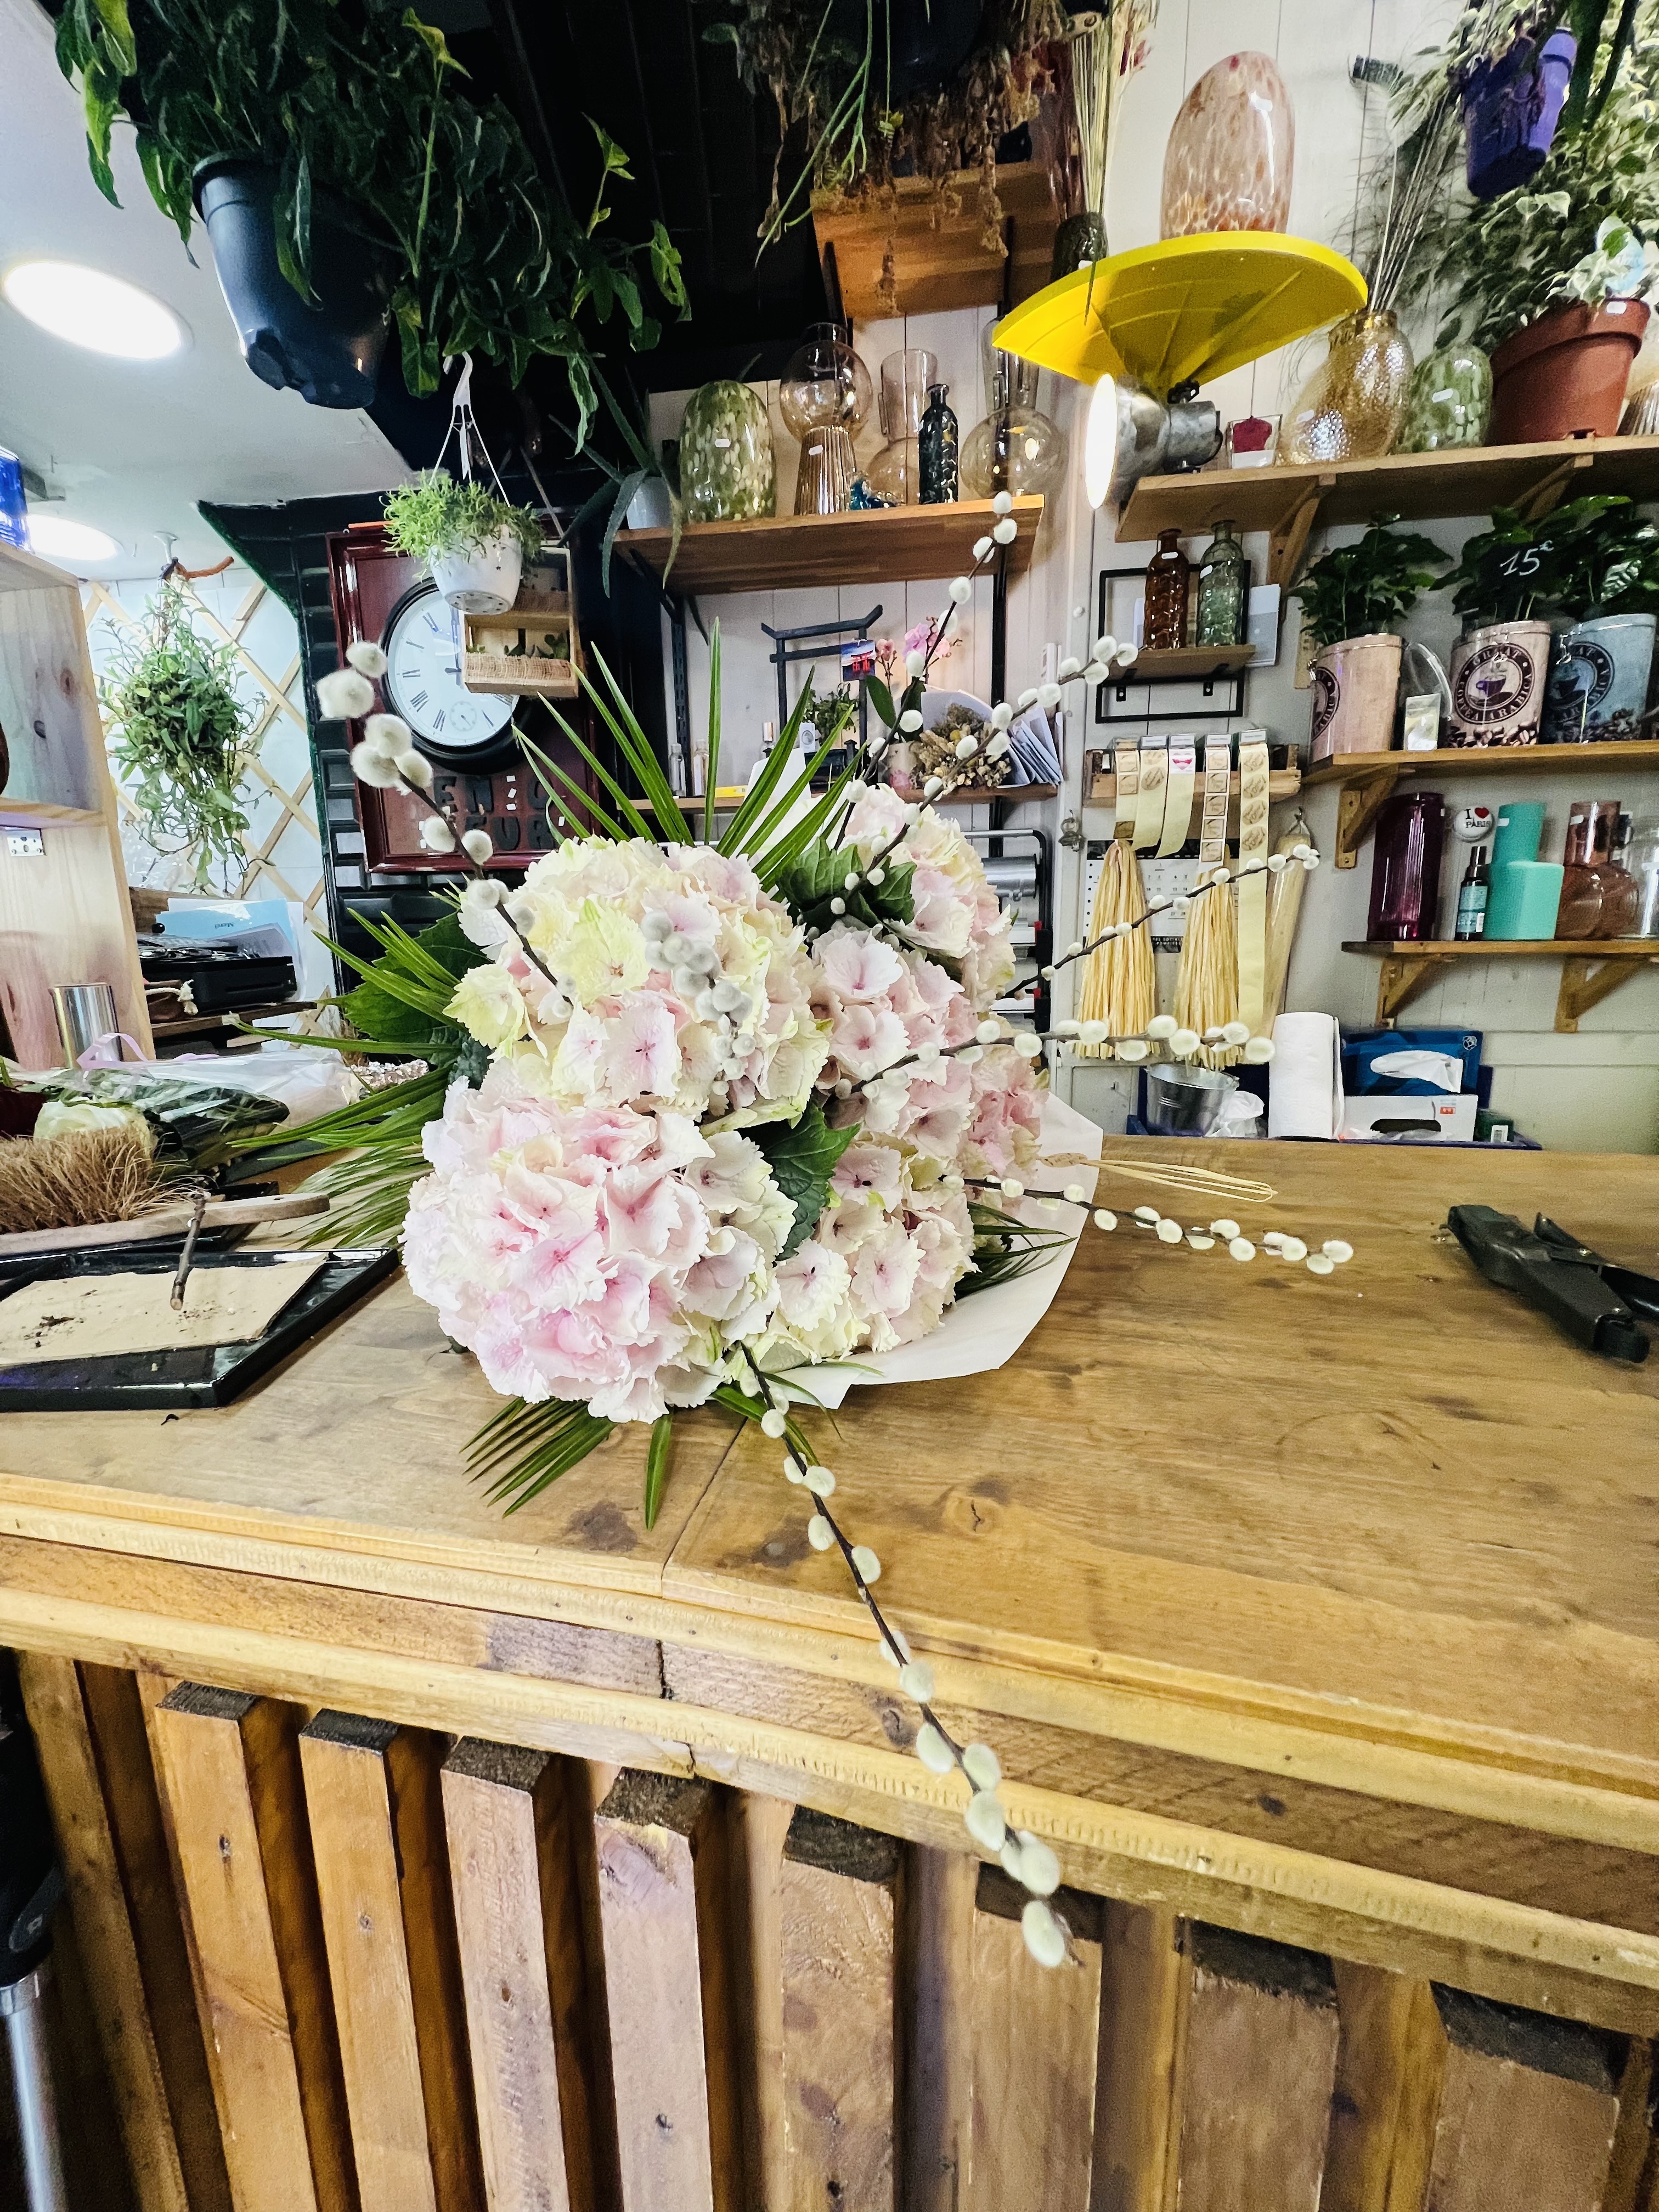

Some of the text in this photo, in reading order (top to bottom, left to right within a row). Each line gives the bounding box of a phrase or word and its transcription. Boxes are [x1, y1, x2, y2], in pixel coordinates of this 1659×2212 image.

[1489, 674, 1533, 720] ARABICA
[1464, 809, 1472, 819] I
[1465, 817, 1492, 828] PARIS
